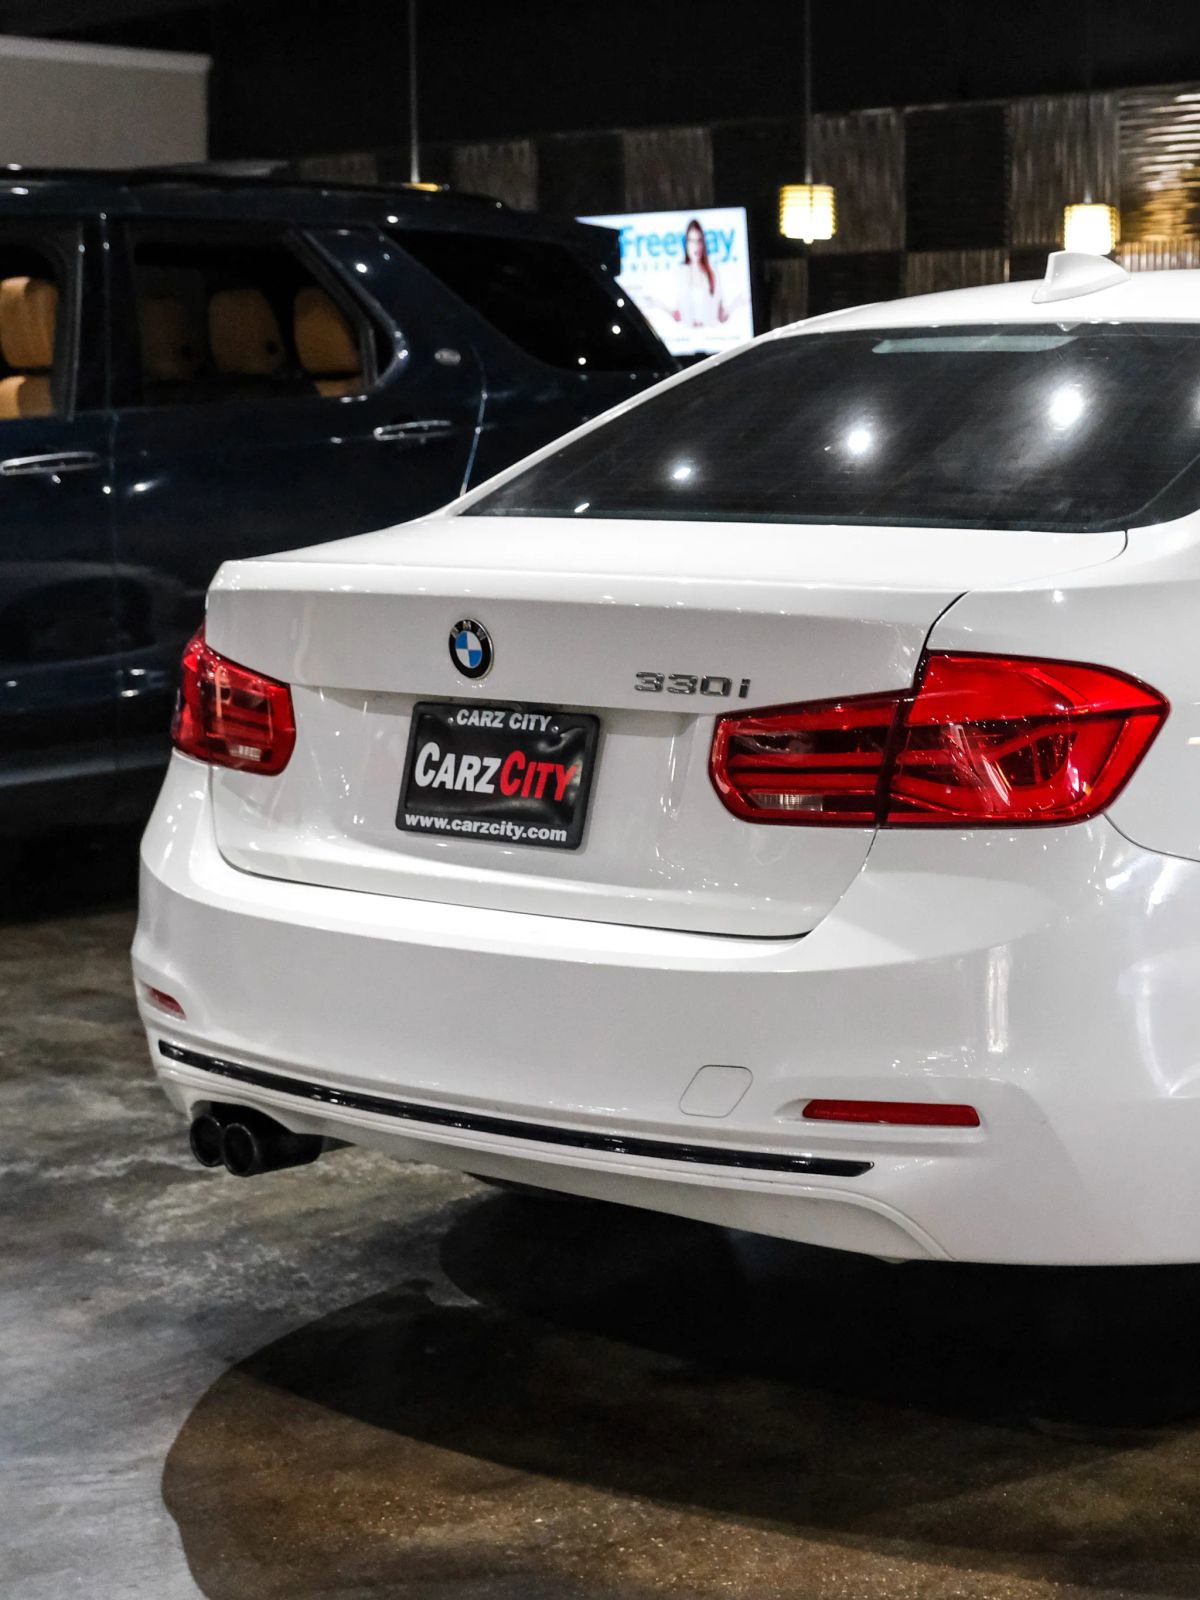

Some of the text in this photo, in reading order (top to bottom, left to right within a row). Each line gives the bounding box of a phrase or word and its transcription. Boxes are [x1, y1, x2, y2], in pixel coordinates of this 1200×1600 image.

[620, 225, 735, 262] Freeay
[634, 671, 752, 699] 330i
[456, 709, 553, 732] CARZ CITY
[405, 813, 567, 843] www.carzcity.com
